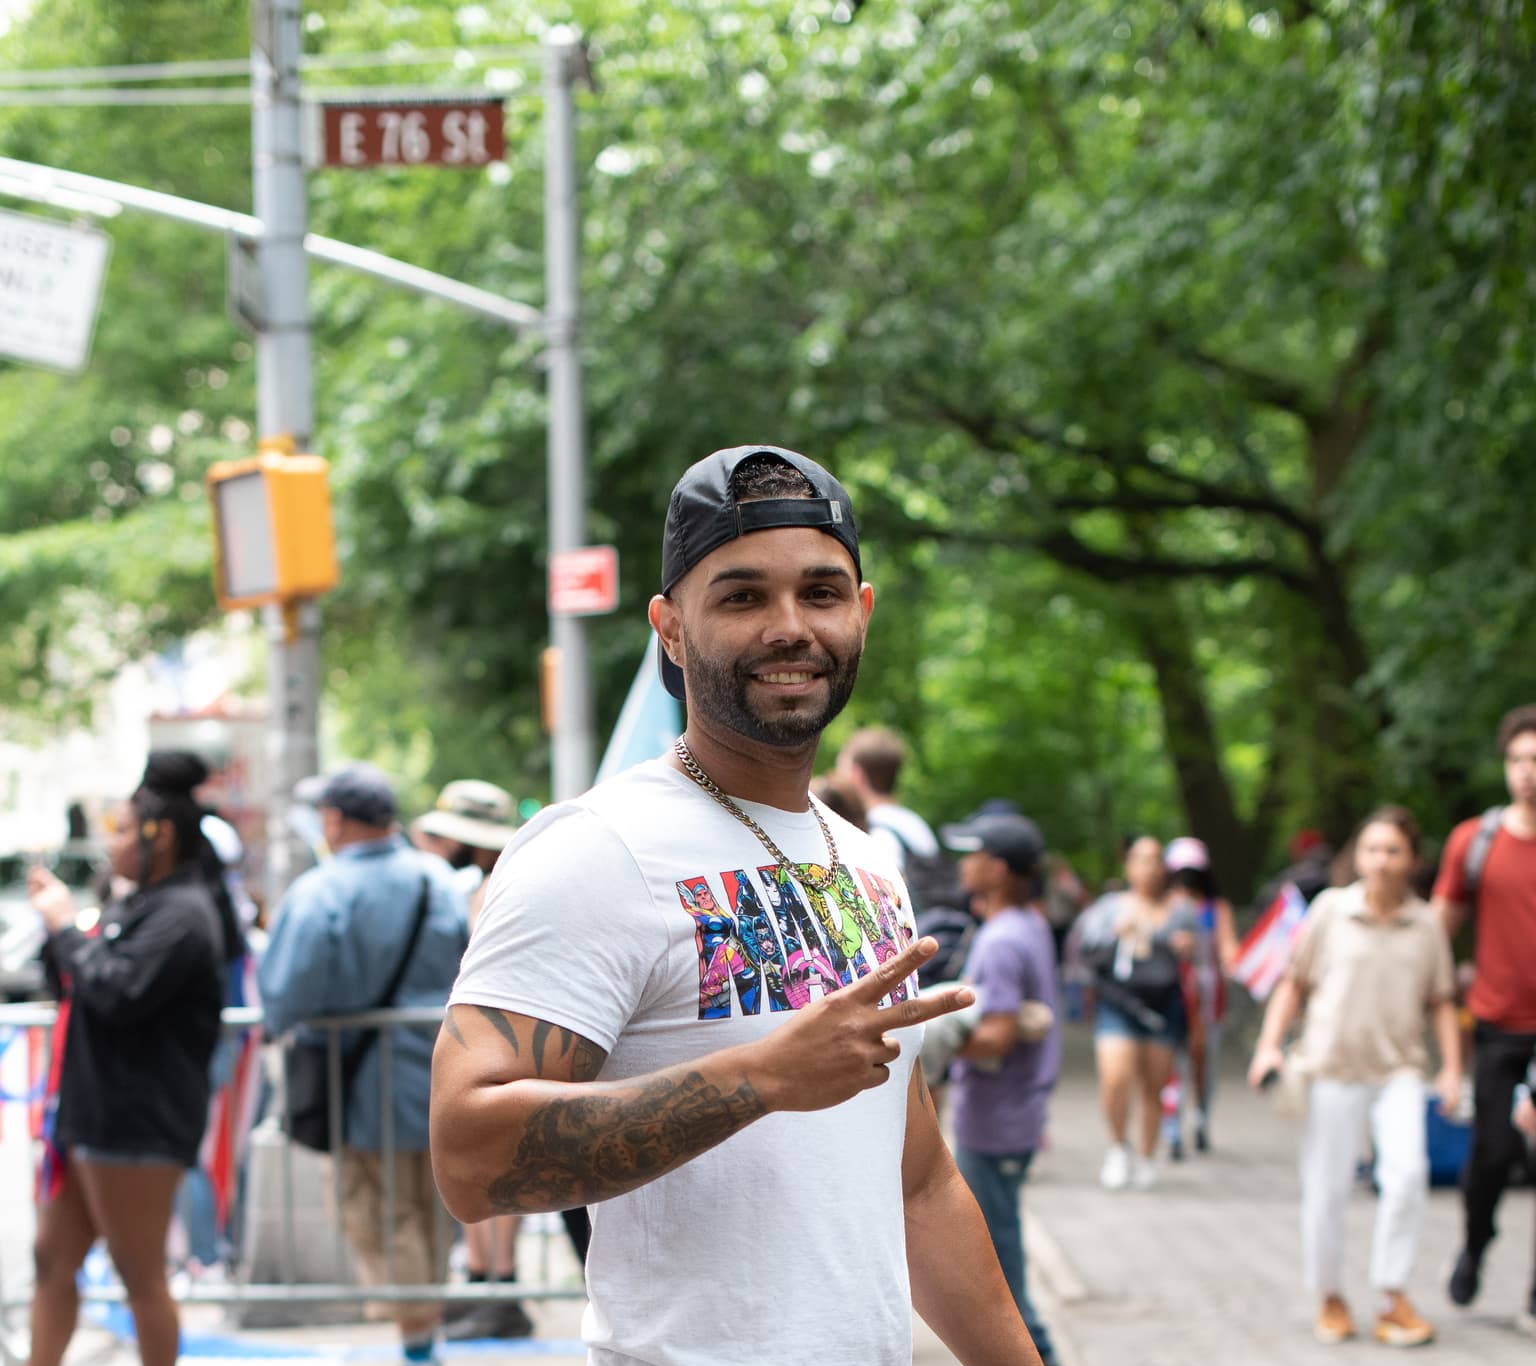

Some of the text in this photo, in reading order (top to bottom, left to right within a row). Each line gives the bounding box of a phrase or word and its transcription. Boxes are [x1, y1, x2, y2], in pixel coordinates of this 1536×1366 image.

[339, 110, 489, 164] E 76 St
[675, 862, 919, 1020] MARVE
